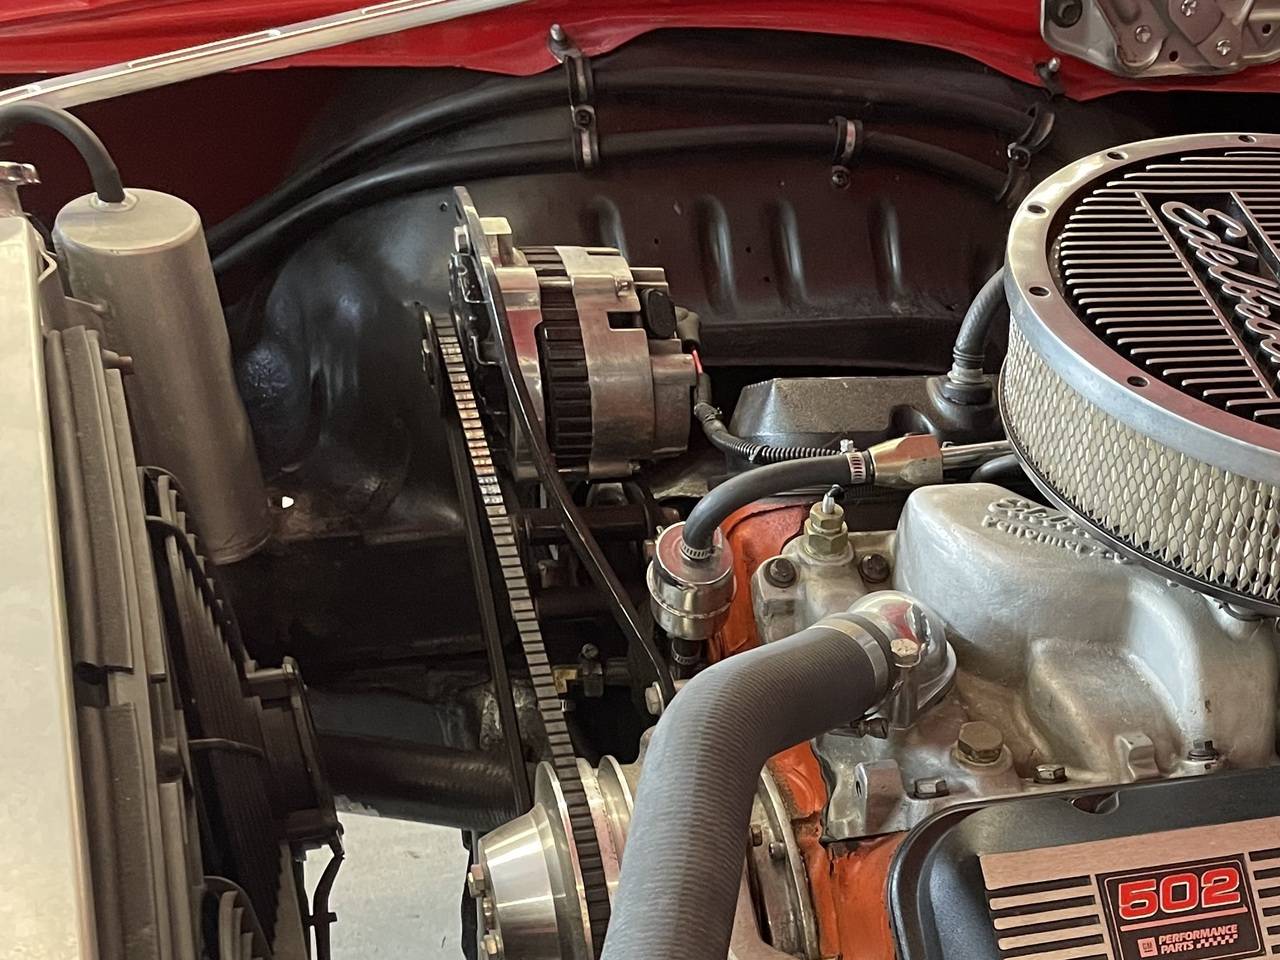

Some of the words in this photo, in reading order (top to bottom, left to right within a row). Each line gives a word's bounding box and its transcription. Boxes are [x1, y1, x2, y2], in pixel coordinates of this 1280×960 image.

[1118, 867, 1241, 920] 502
[1159, 924, 1238, 945] PERFORMANCE
[1161, 941, 1194, 955] PARTS
